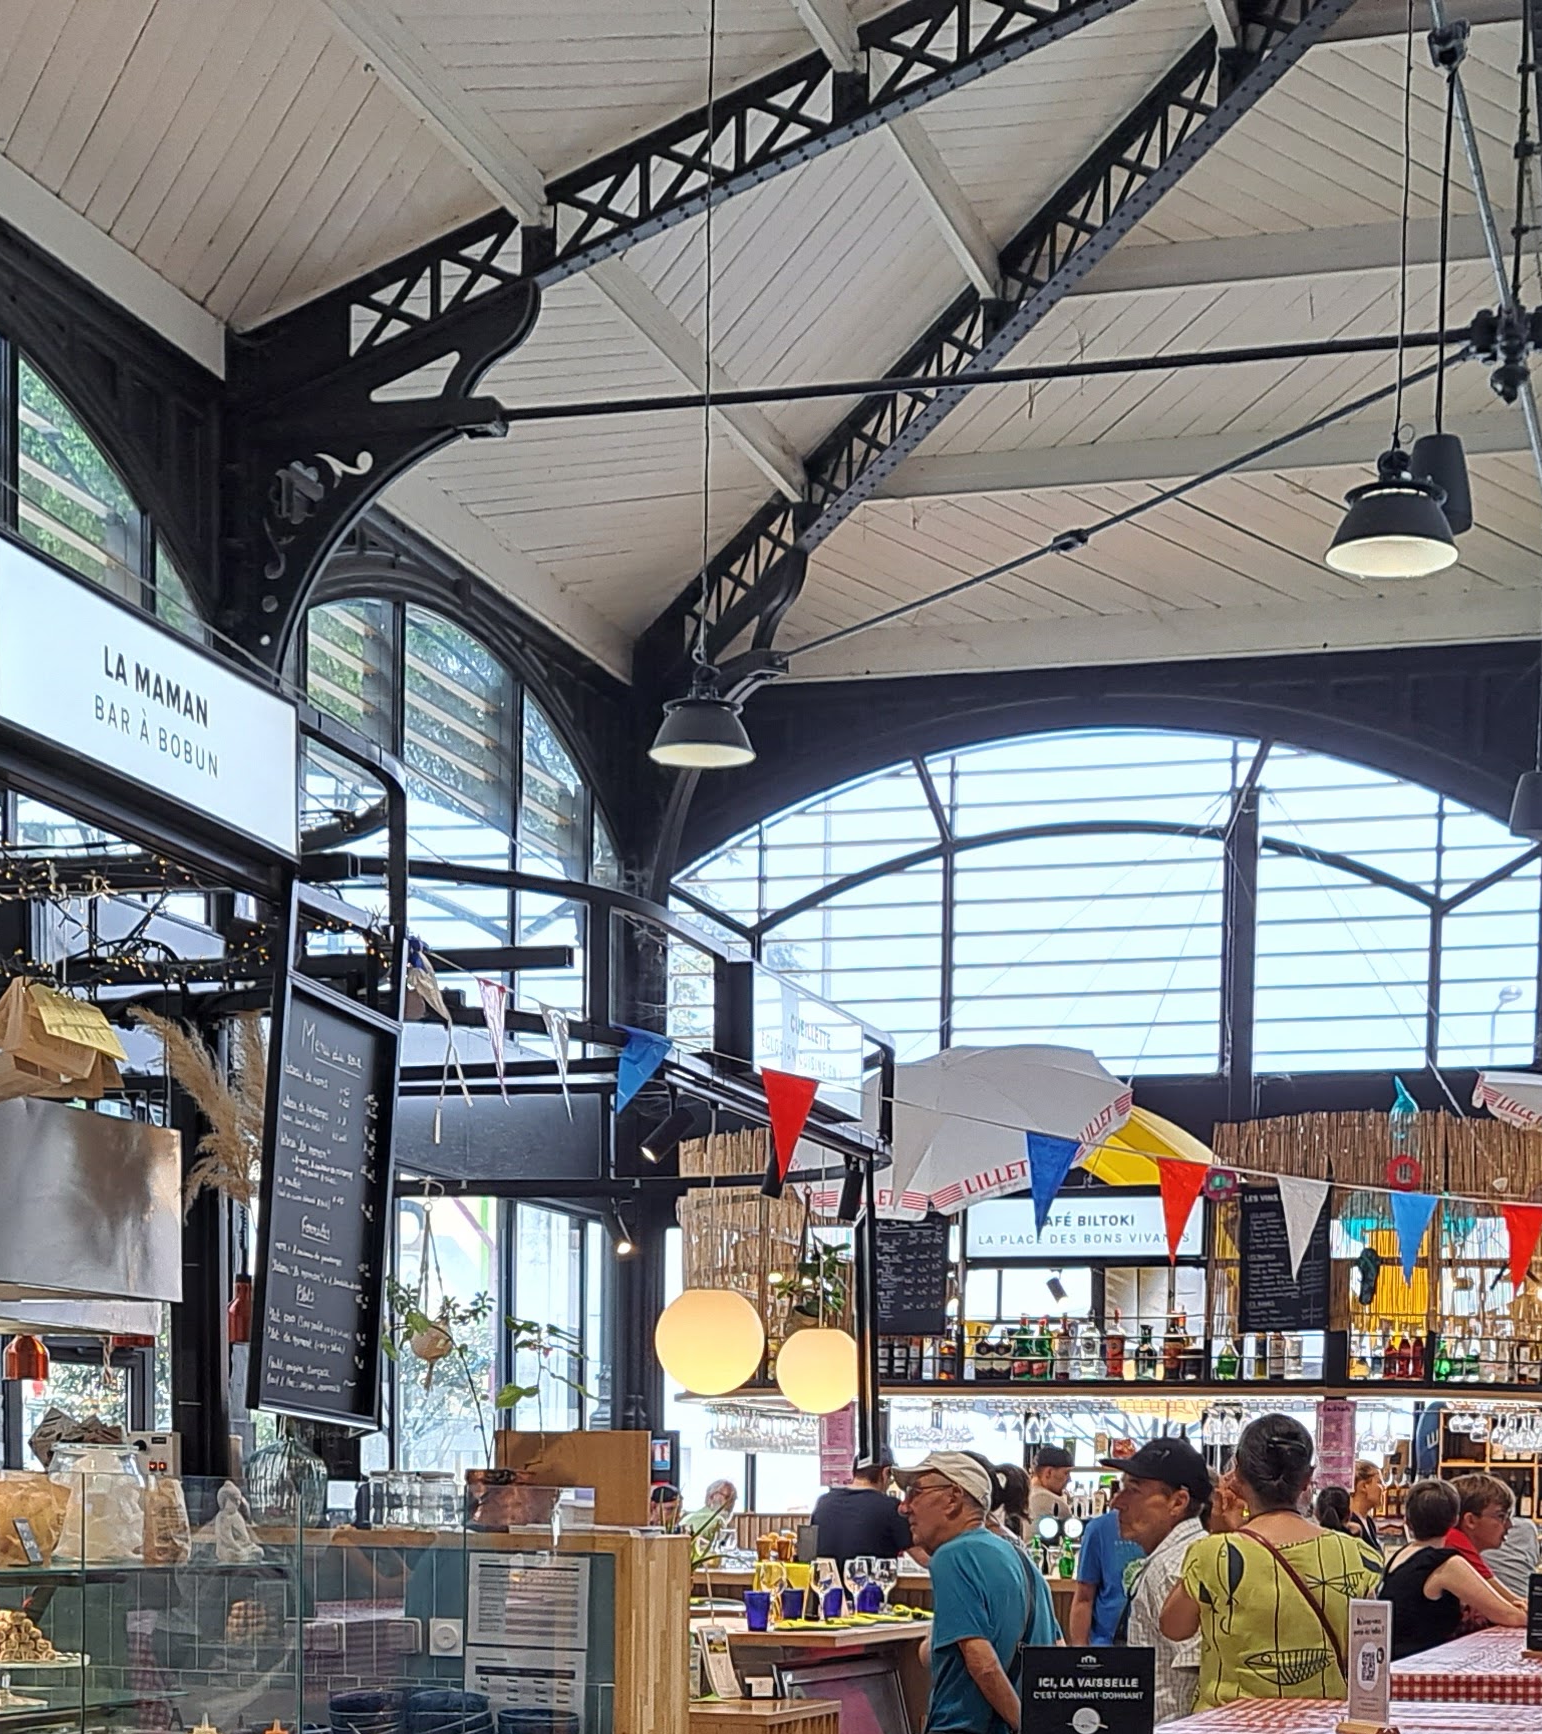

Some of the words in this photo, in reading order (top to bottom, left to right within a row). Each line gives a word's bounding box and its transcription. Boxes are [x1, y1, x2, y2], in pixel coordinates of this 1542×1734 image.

[104, 645, 127, 687] LA
[135, 662, 209, 728] MAMAN
[94, 694, 131, 734] BAR
[140, 709, 149, 745] À
[158, 727, 219, 778] BOBUN
[964, 1160, 1028, 1195] LILLET
[1043, 1211, 1071, 1227] AFÉ
[1077, 1214, 1135, 1227] BILTOKI
[978, 1234, 994, 1245] LA
[1050, 1233, 1077, 1245] DES
[1084, 1232, 1123, 1244] BONS
[1038, 1677, 1058, 1690] ICI,
[1060, 1677, 1074, 1688] LA
[1077, 1677, 1139, 1688] VAISSELLE
[1033, 1691, 1057, 1699] C'EST
